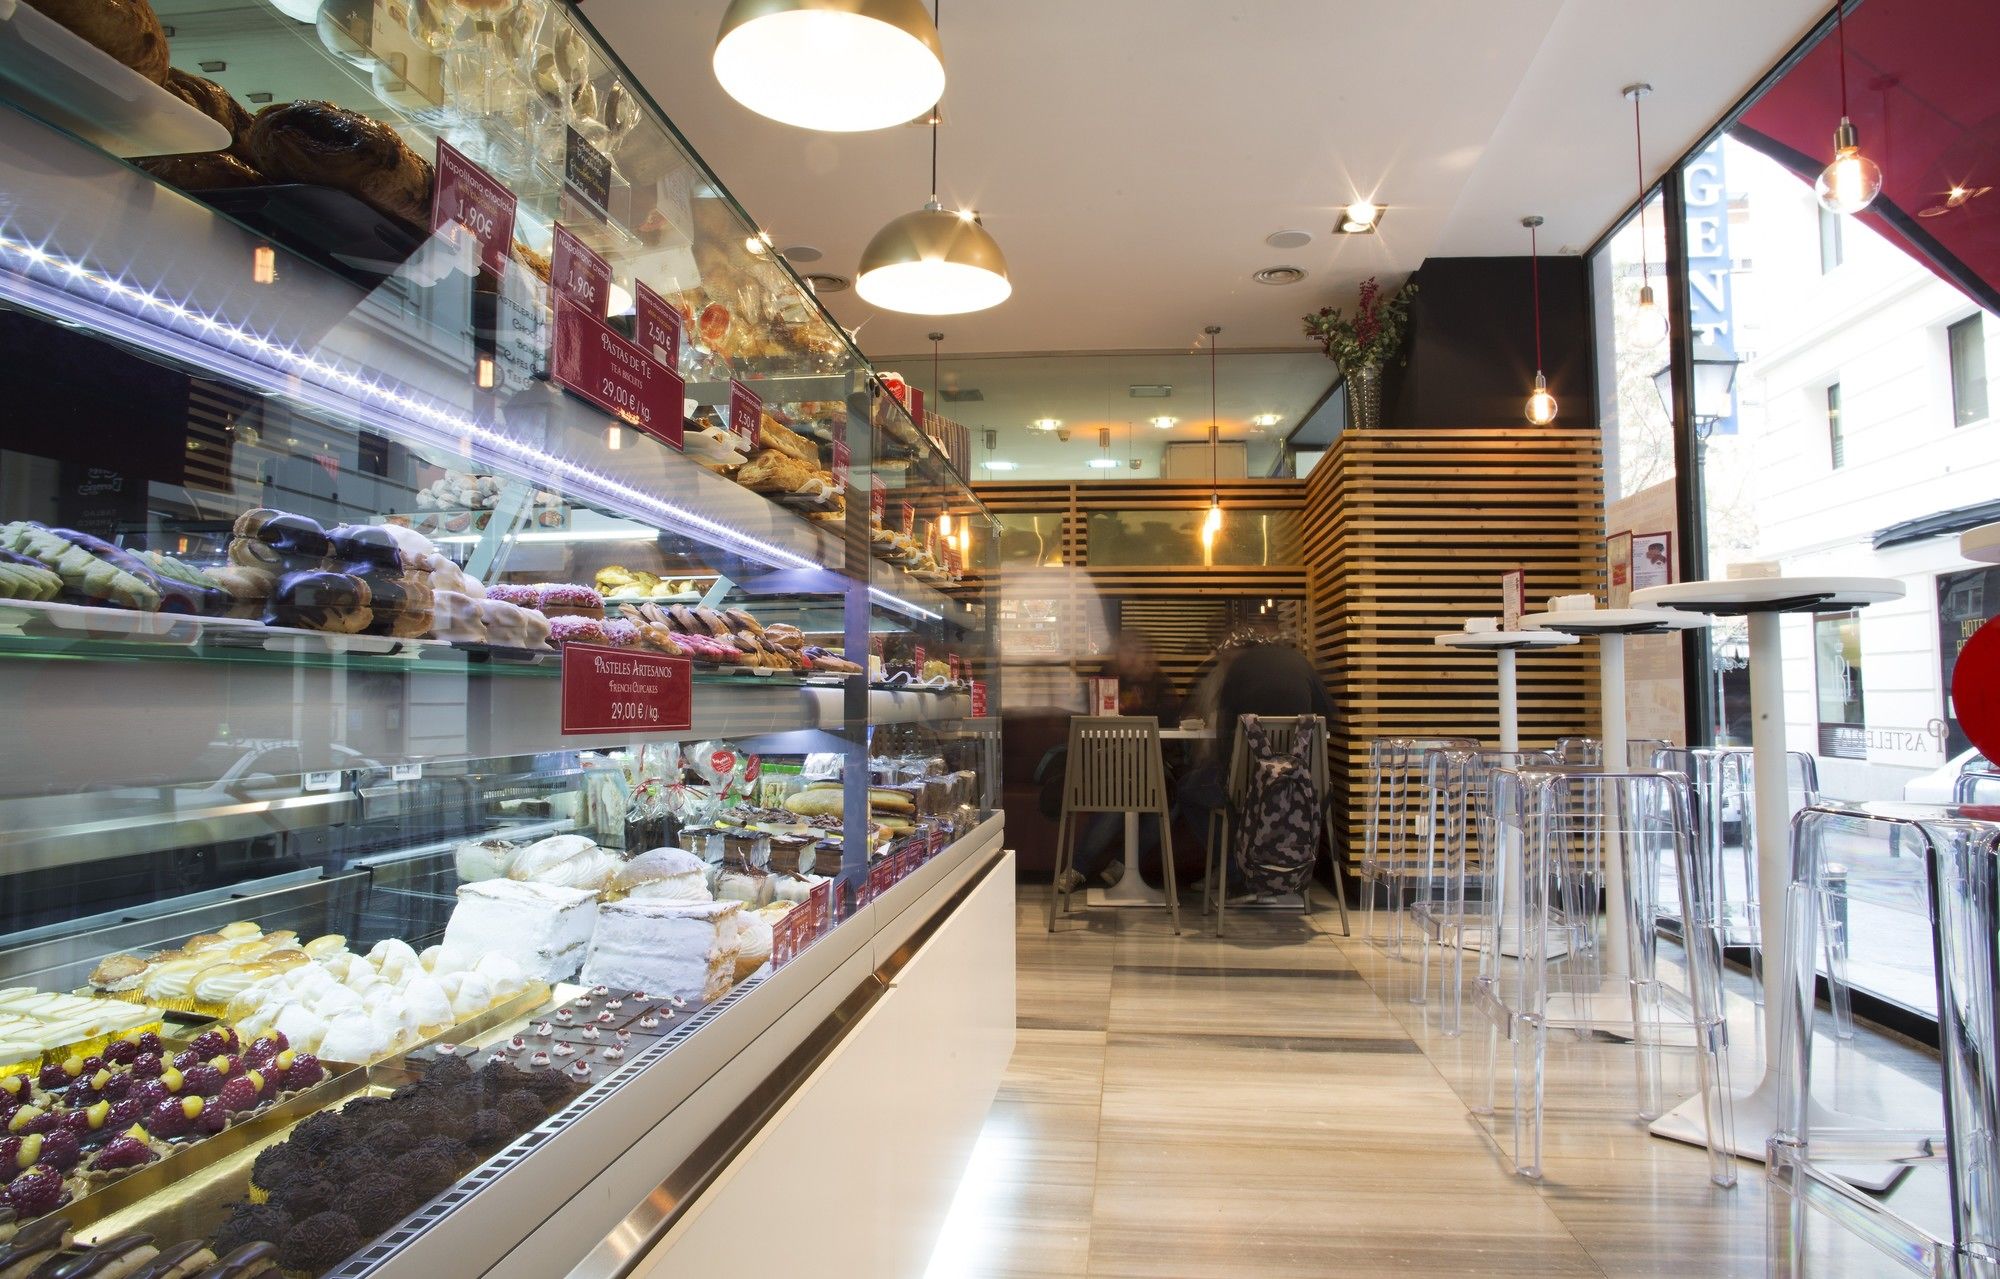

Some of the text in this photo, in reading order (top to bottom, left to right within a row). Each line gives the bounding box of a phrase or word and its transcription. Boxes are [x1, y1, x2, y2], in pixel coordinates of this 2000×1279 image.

[442, 152, 483, 192] Napolitana
[457, 198, 493, 239] 1,90€
[559, 233, 592, 267] Napolitana
[1684, 141, 1729, 346] GENT
[568, 269, 596, 303] 1,90€
[649, 321, 671, 351] 2,50 €
[601, 332, 651, 379] PASTAS DE TE
[610, 362, 643, 389] TEA BISCUITS
[602, 378, 628, 406] 29,00
[629, 394, 636, 411] €
[1961, 618, 1987, 638] HOTE
[594, 655, 672, 678] PASTELES ARTESANOS
[609, 680, 658, 694] FRENCH CUPCAKES
[611, 702, 636, 720] 29,00
[637, 702, 644, 719] €
[649, 706, 660, 722] kg.
